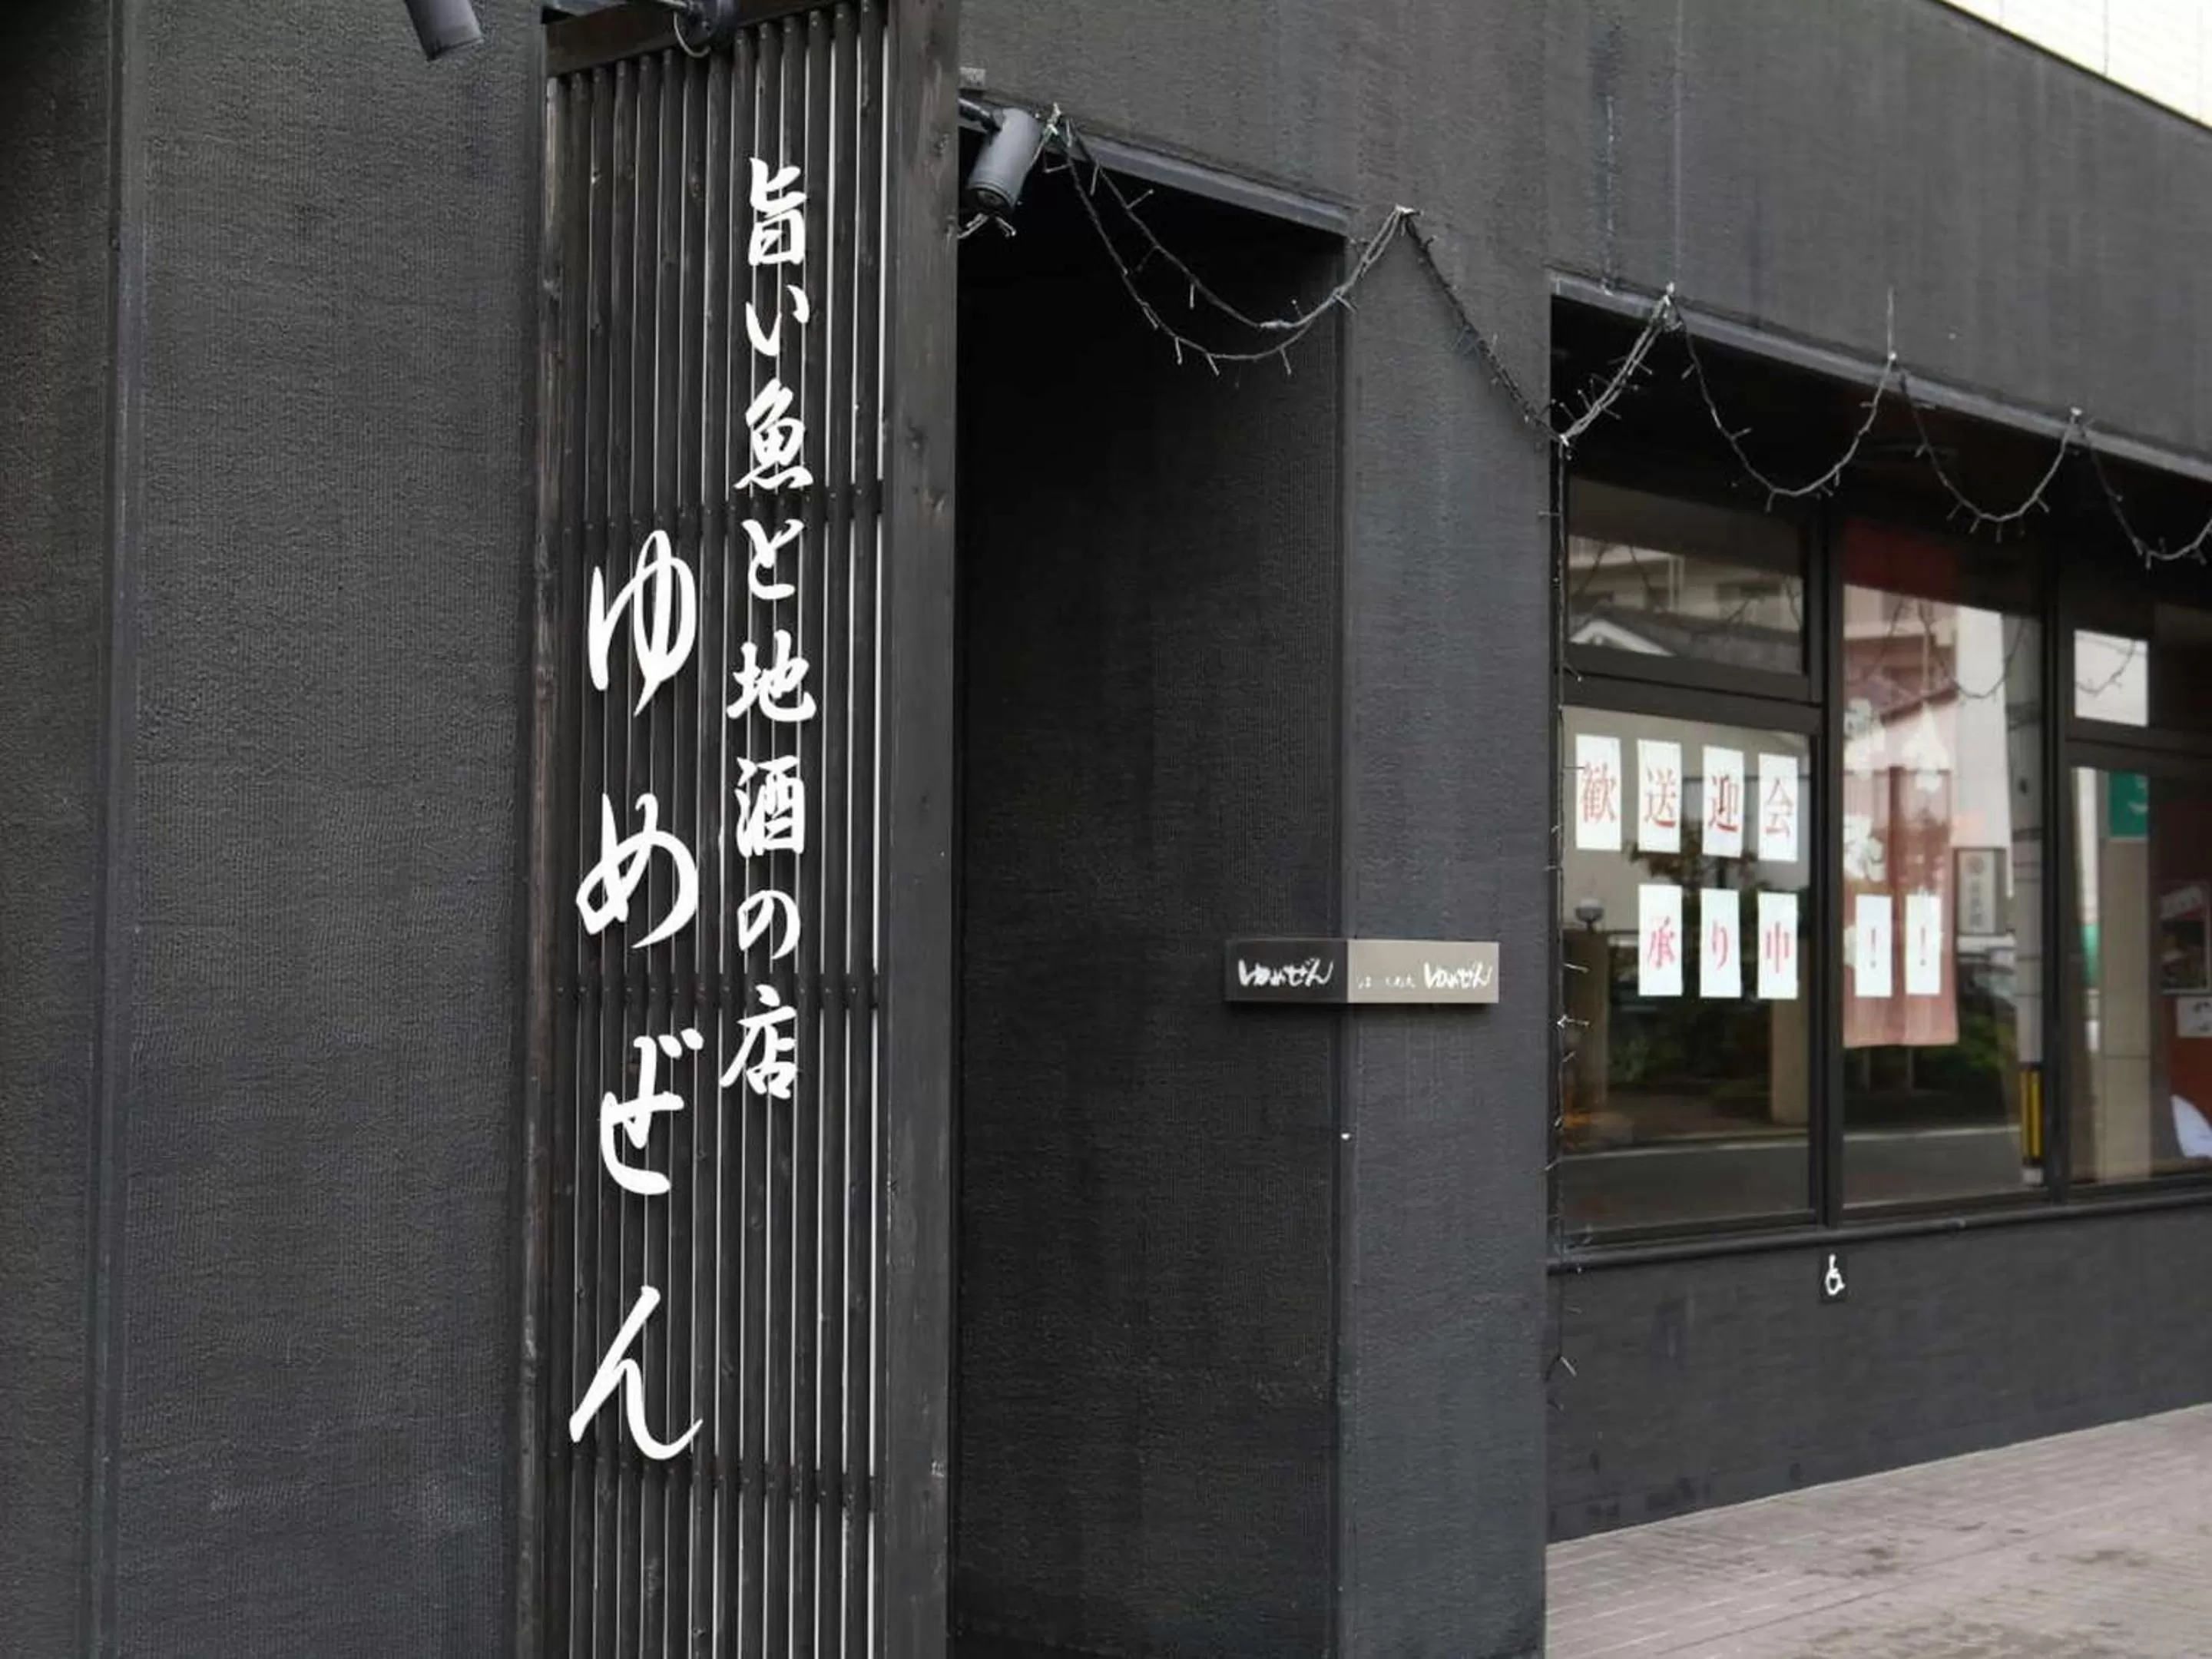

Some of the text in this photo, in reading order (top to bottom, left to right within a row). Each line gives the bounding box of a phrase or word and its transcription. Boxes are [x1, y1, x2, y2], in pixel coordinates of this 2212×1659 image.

[720, 157, 816, 1099] 旨い魚と地酒の店
[1581, 762, 1794, 837] 歓送迎会
[569, 530, 704, 1461] ゆめぜん
[1237, 957, 1335, 987] ゆめぜん
